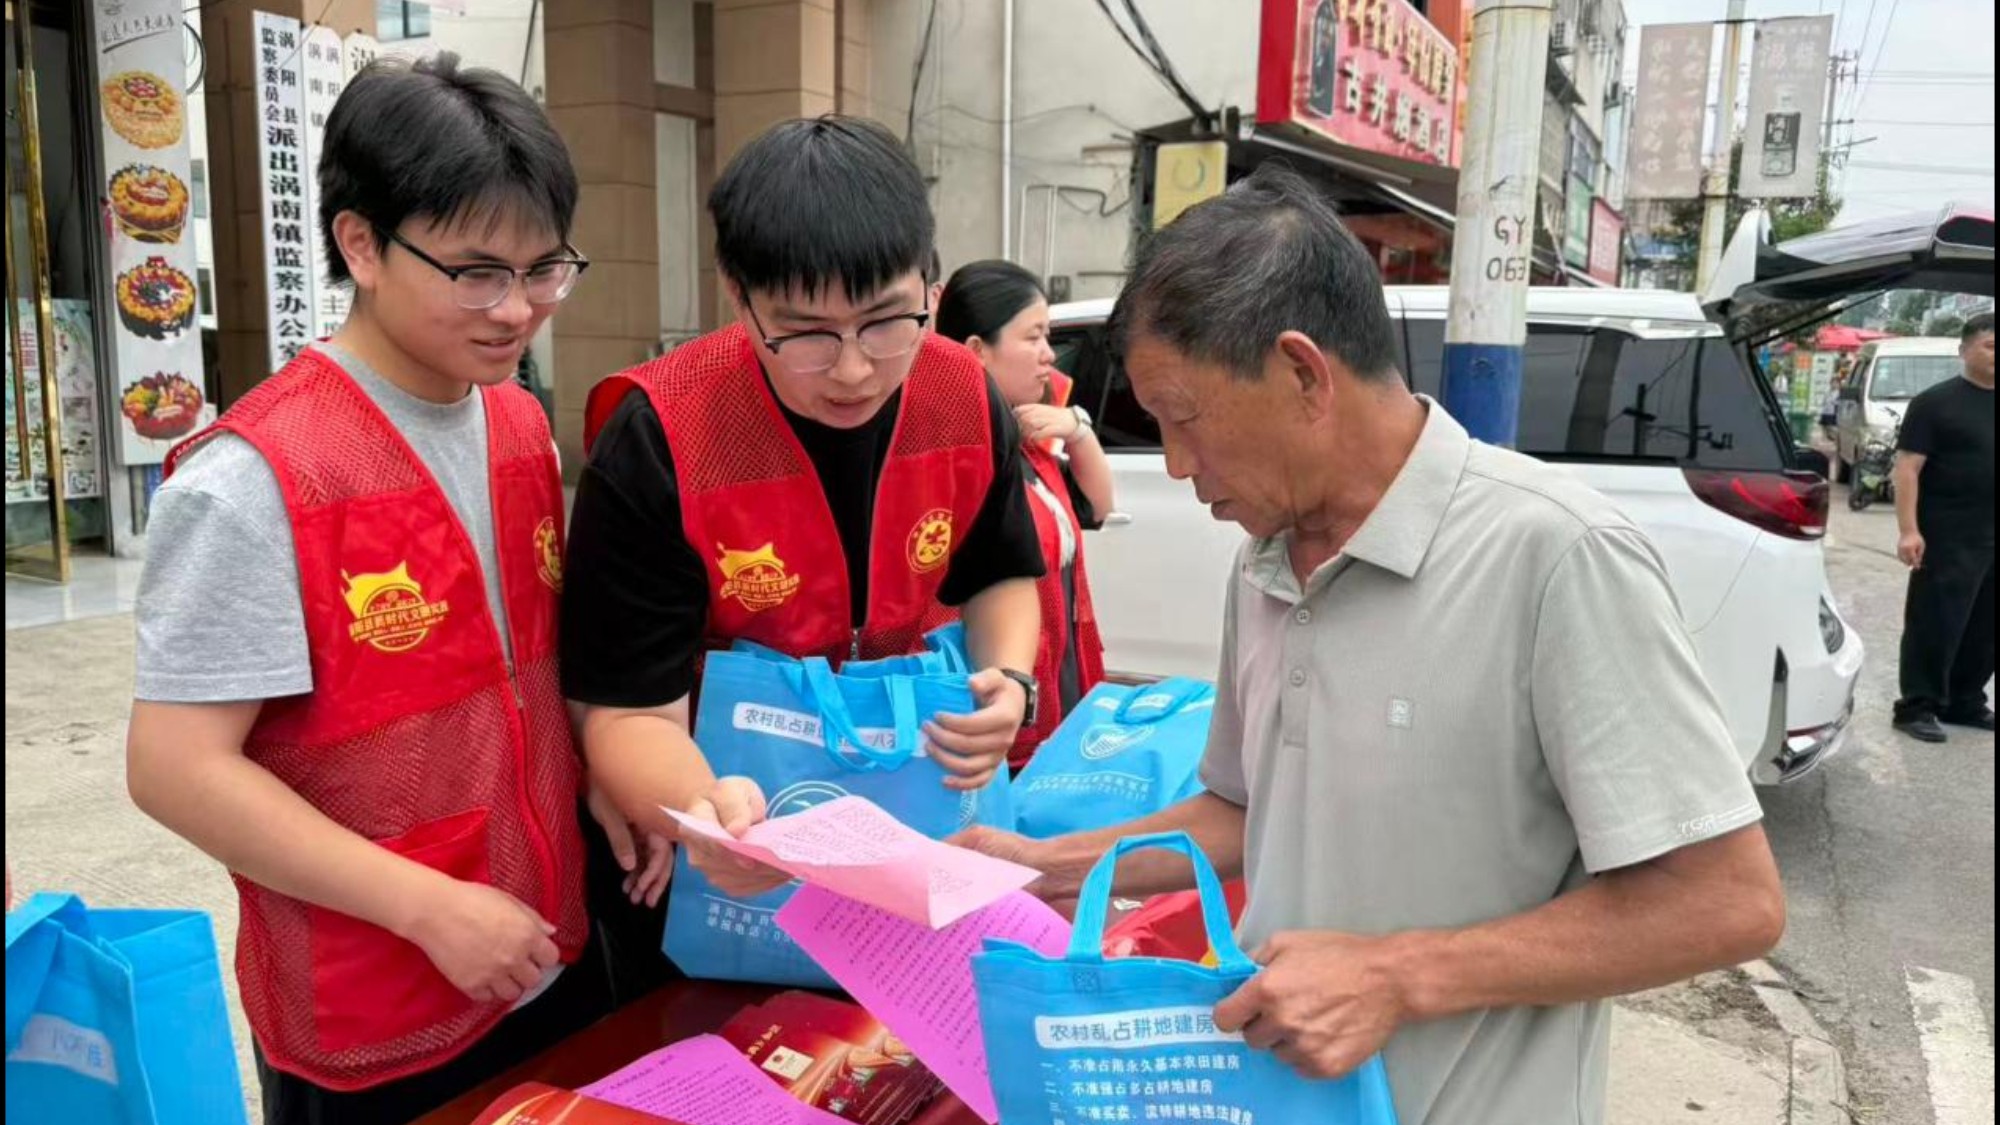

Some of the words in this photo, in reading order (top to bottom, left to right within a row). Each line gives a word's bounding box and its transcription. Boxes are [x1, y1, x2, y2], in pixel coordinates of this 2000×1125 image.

[262, 27, 281, 123] 监察委员会
[278, 31, 298, 125] 涡阳县
[1494, 215, 1527, 245] GY
[1486, 256, 1527, 282] 063
[1049, 1013, 1214, 1042] 农村乱占耕地建房
